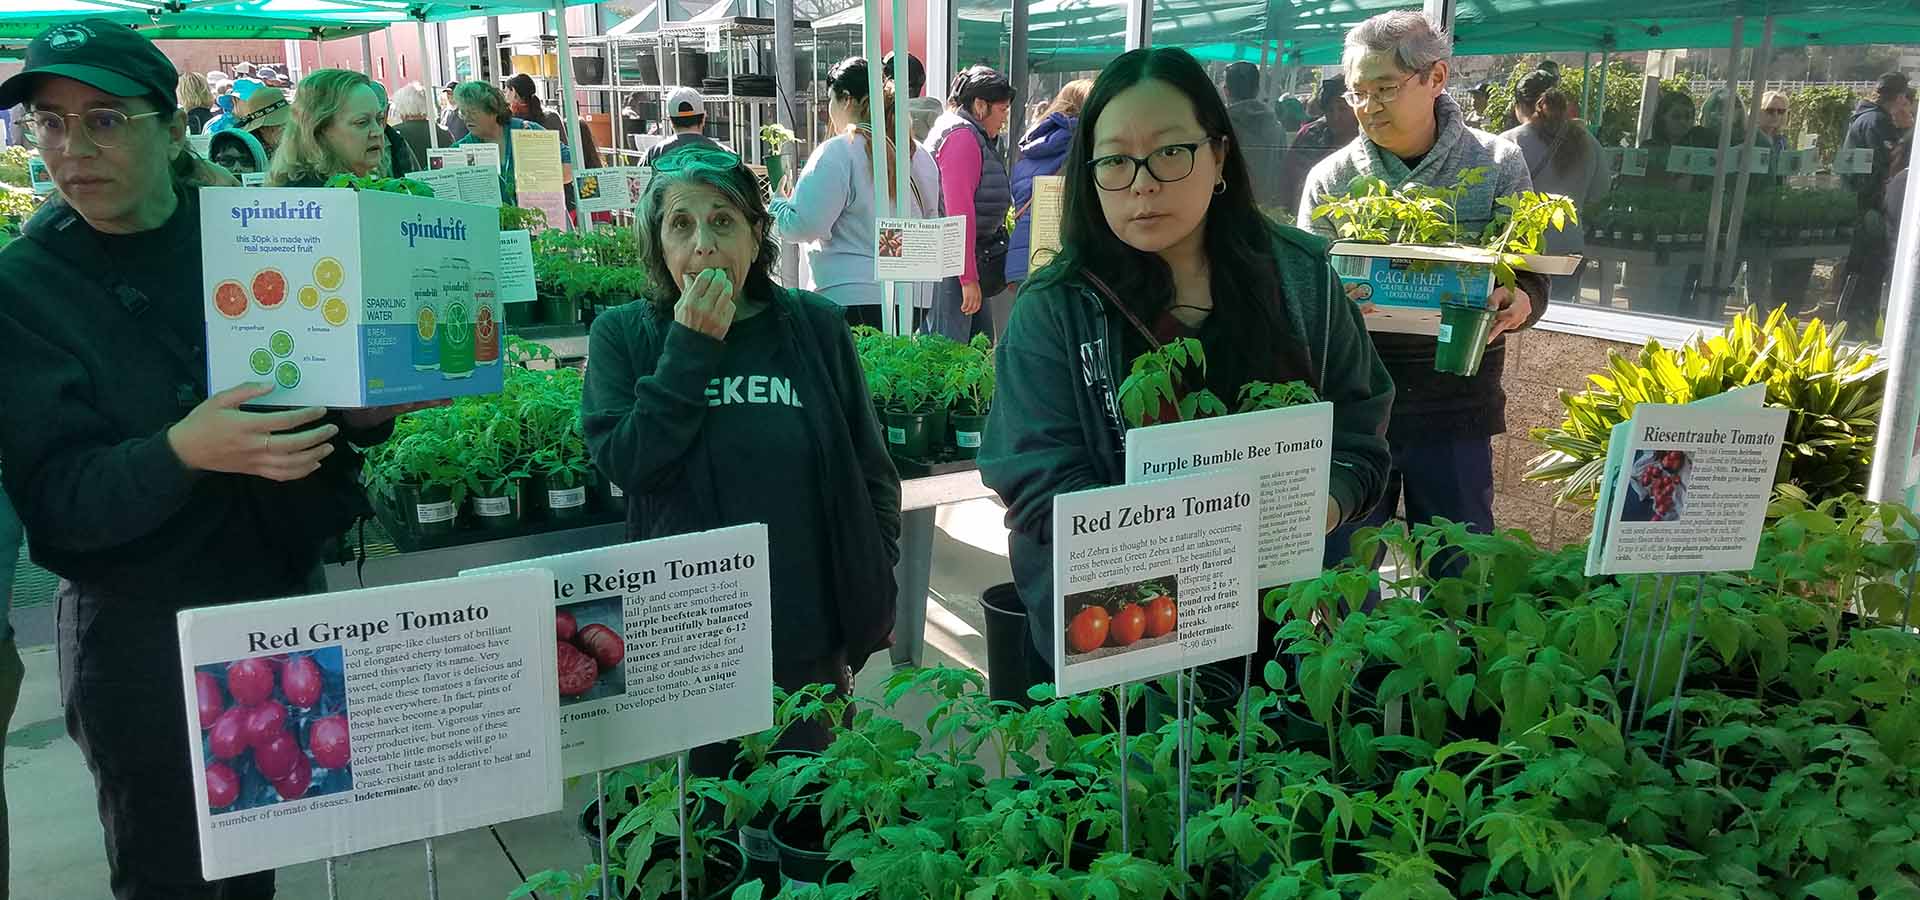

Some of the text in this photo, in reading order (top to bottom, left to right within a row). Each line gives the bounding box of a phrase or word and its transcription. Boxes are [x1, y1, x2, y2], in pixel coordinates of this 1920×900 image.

[232, 200, 322, 227] spindrift
[236, 235, 250, 243] this
[252, 235, 271, 244] 30pk
[280, 236, 301, 244] made
[303, 236, 320, 244] with
[401, 214, 466, 248] spindrift
[244, 244, 313, 254] real squeezed fruit
[366, 298, 406, 309] SPARKLING
[367, 311, 392, 321] WATER
[704, 376, 803, 408] EKEN
[1643, 426, 1775, 445] Riesentraube Tomato
[1143, 436, 1323, 476] Purple Bumble Bee Tomato
[1072, 490, 1250, 536] Red Zebra Tomato
[584, 568, 656, 593] Reign
[665, 552, 755, 582] Tomato
[624, 591, 738, 618] tall plants smothered
[626, 580, 737, 606] Tidy compact 3-foot
[248, 603, 489, 653] Red Grape Tomato
[625, 602, 751, 632] purple beefsteak tomatoes
[626, 611, 748, 640] with beautifully balanced
[375, 639, 424, 656] grape-like
[424, 635, 461, 646] clusters
[474, 626, 510, 638] brilliant
[626, 637, 722, 663] ounces ideal
[659, 634, 685, 646] Fruit
[684, 629, 725, 641] average
[363, 639, 509, 667] elongated cherry tomatoes have
[627, 650, 726, 675] slicing sandwiches
[346, 669, 380, 682] earned
[379, 666, 399, 677] this
[399, 662, 434, 674] variety
[480, 653, 499, 662] Very
[380, 676, 422, 689] complex
[421, 672, 452, 682] flavor
[462, 664, 504, 676] delicious
[668, 659, 739, 679] double nice
[365, 673, 508, 703] made these tomatoes favorite
[628, 688, 655, 698] sauce
[702, 671, 736, 683] unique
[349, 706, 382, 721] people
[476, 687, 501, 699] pints
[400, 702, 483, 722] become popular
[615, 694, 667, 712] Developed
[680, 688, 707, 698] Dean
[352, 725, 410, 743] supermarket
[438, 715, 480, 728] Vigorous
[479, 710, 504, 720] vines
[353, 745, 375, 754] very
[353, 740, 463, 766] delectable little morsels
[355, 754, 512, 790] Crack-resistant tolerant heat
[388, 760, 412, 772] Their
[412, 758, 435, 768] taste
[218, 815, 256, 828] number
[273, 806, 306, 818] tomato
[437, 778, 458, 787] days
